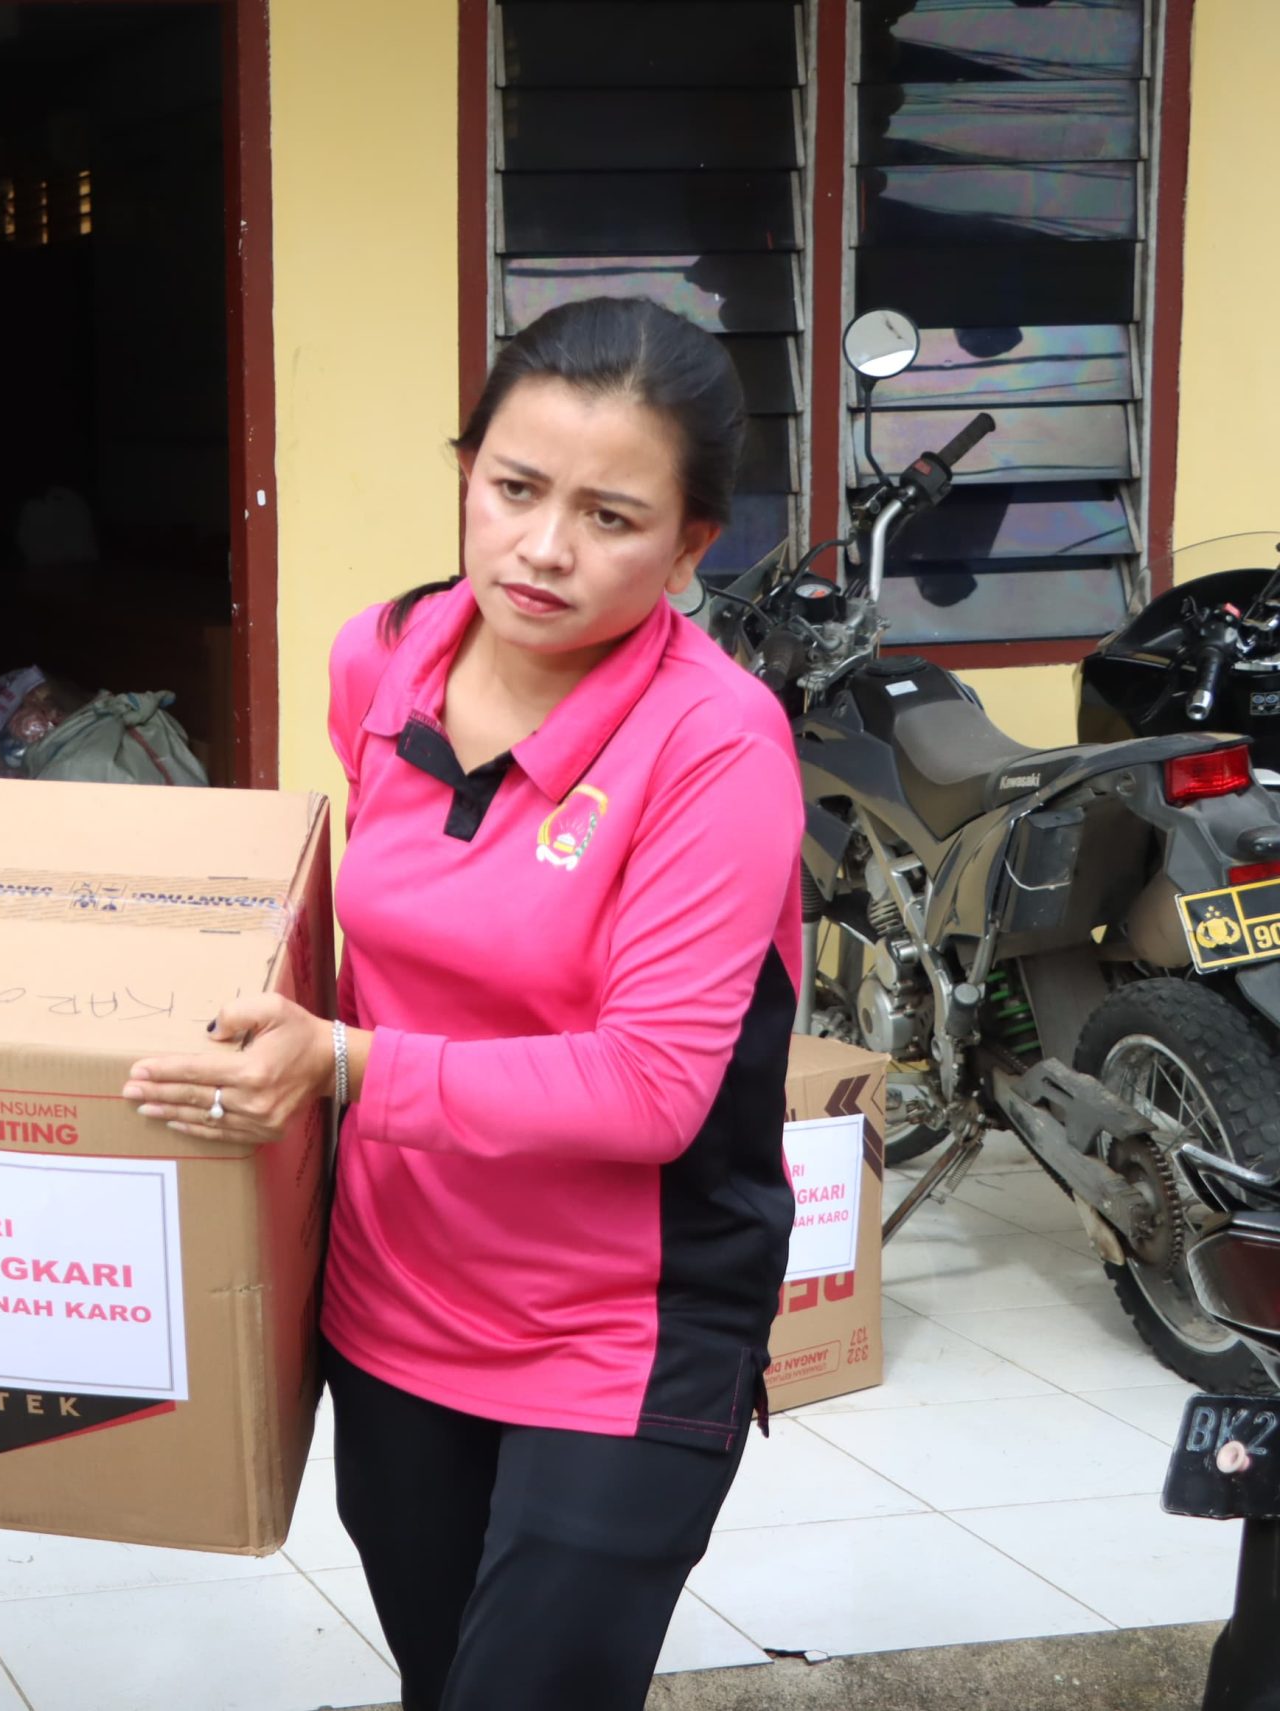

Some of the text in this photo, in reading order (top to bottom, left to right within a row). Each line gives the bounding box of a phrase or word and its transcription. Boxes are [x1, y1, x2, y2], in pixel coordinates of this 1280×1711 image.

[817, 1209, 849, 1225] KARO
[65, 1301, 152, 1323] KARO
[784, 1349, 829, 1370] JANGAN
